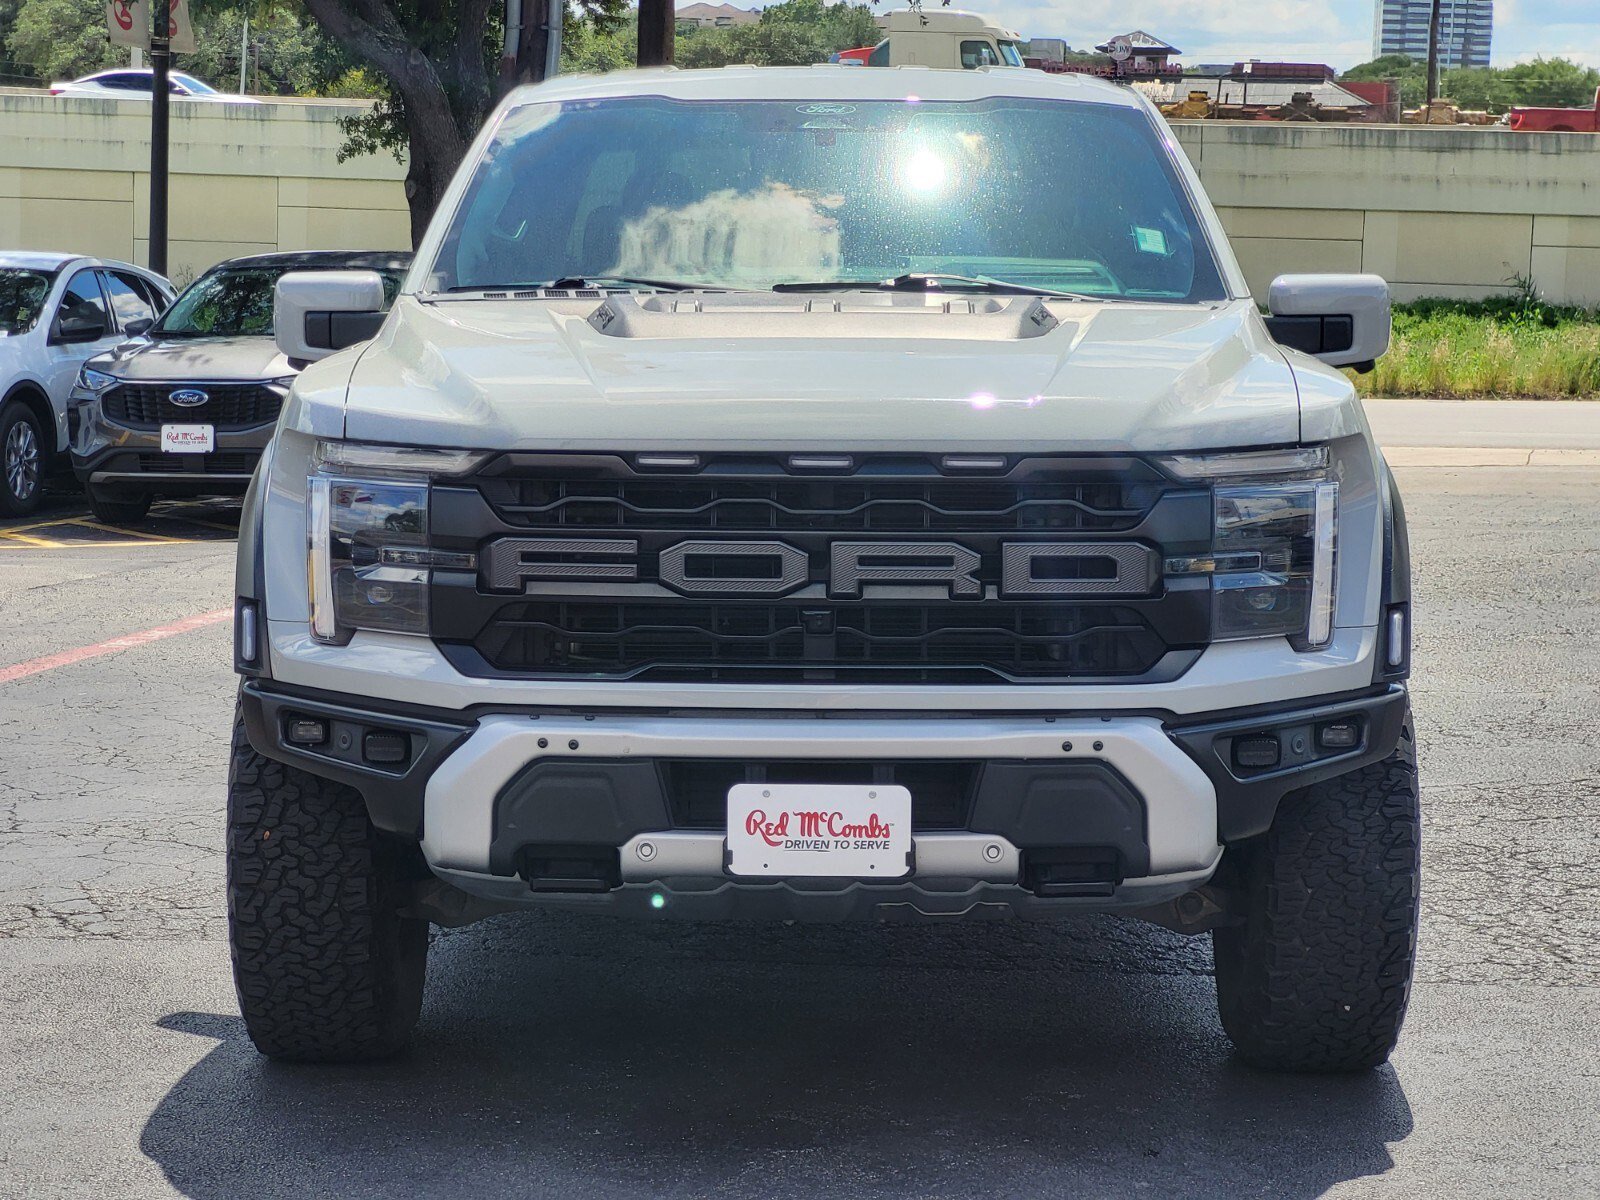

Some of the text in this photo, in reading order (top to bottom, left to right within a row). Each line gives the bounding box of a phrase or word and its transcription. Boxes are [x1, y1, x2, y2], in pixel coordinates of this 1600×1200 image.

[806, 104, 846, 113] Ford
[178, 393, 198, 402] Ford
[167, 432, 179, 443] Red
[487, 536, 1158, 597] FORD
[745, 809, 789, 847] Red
[785, 839, 890, 850] DRIVEN TO SERVE
